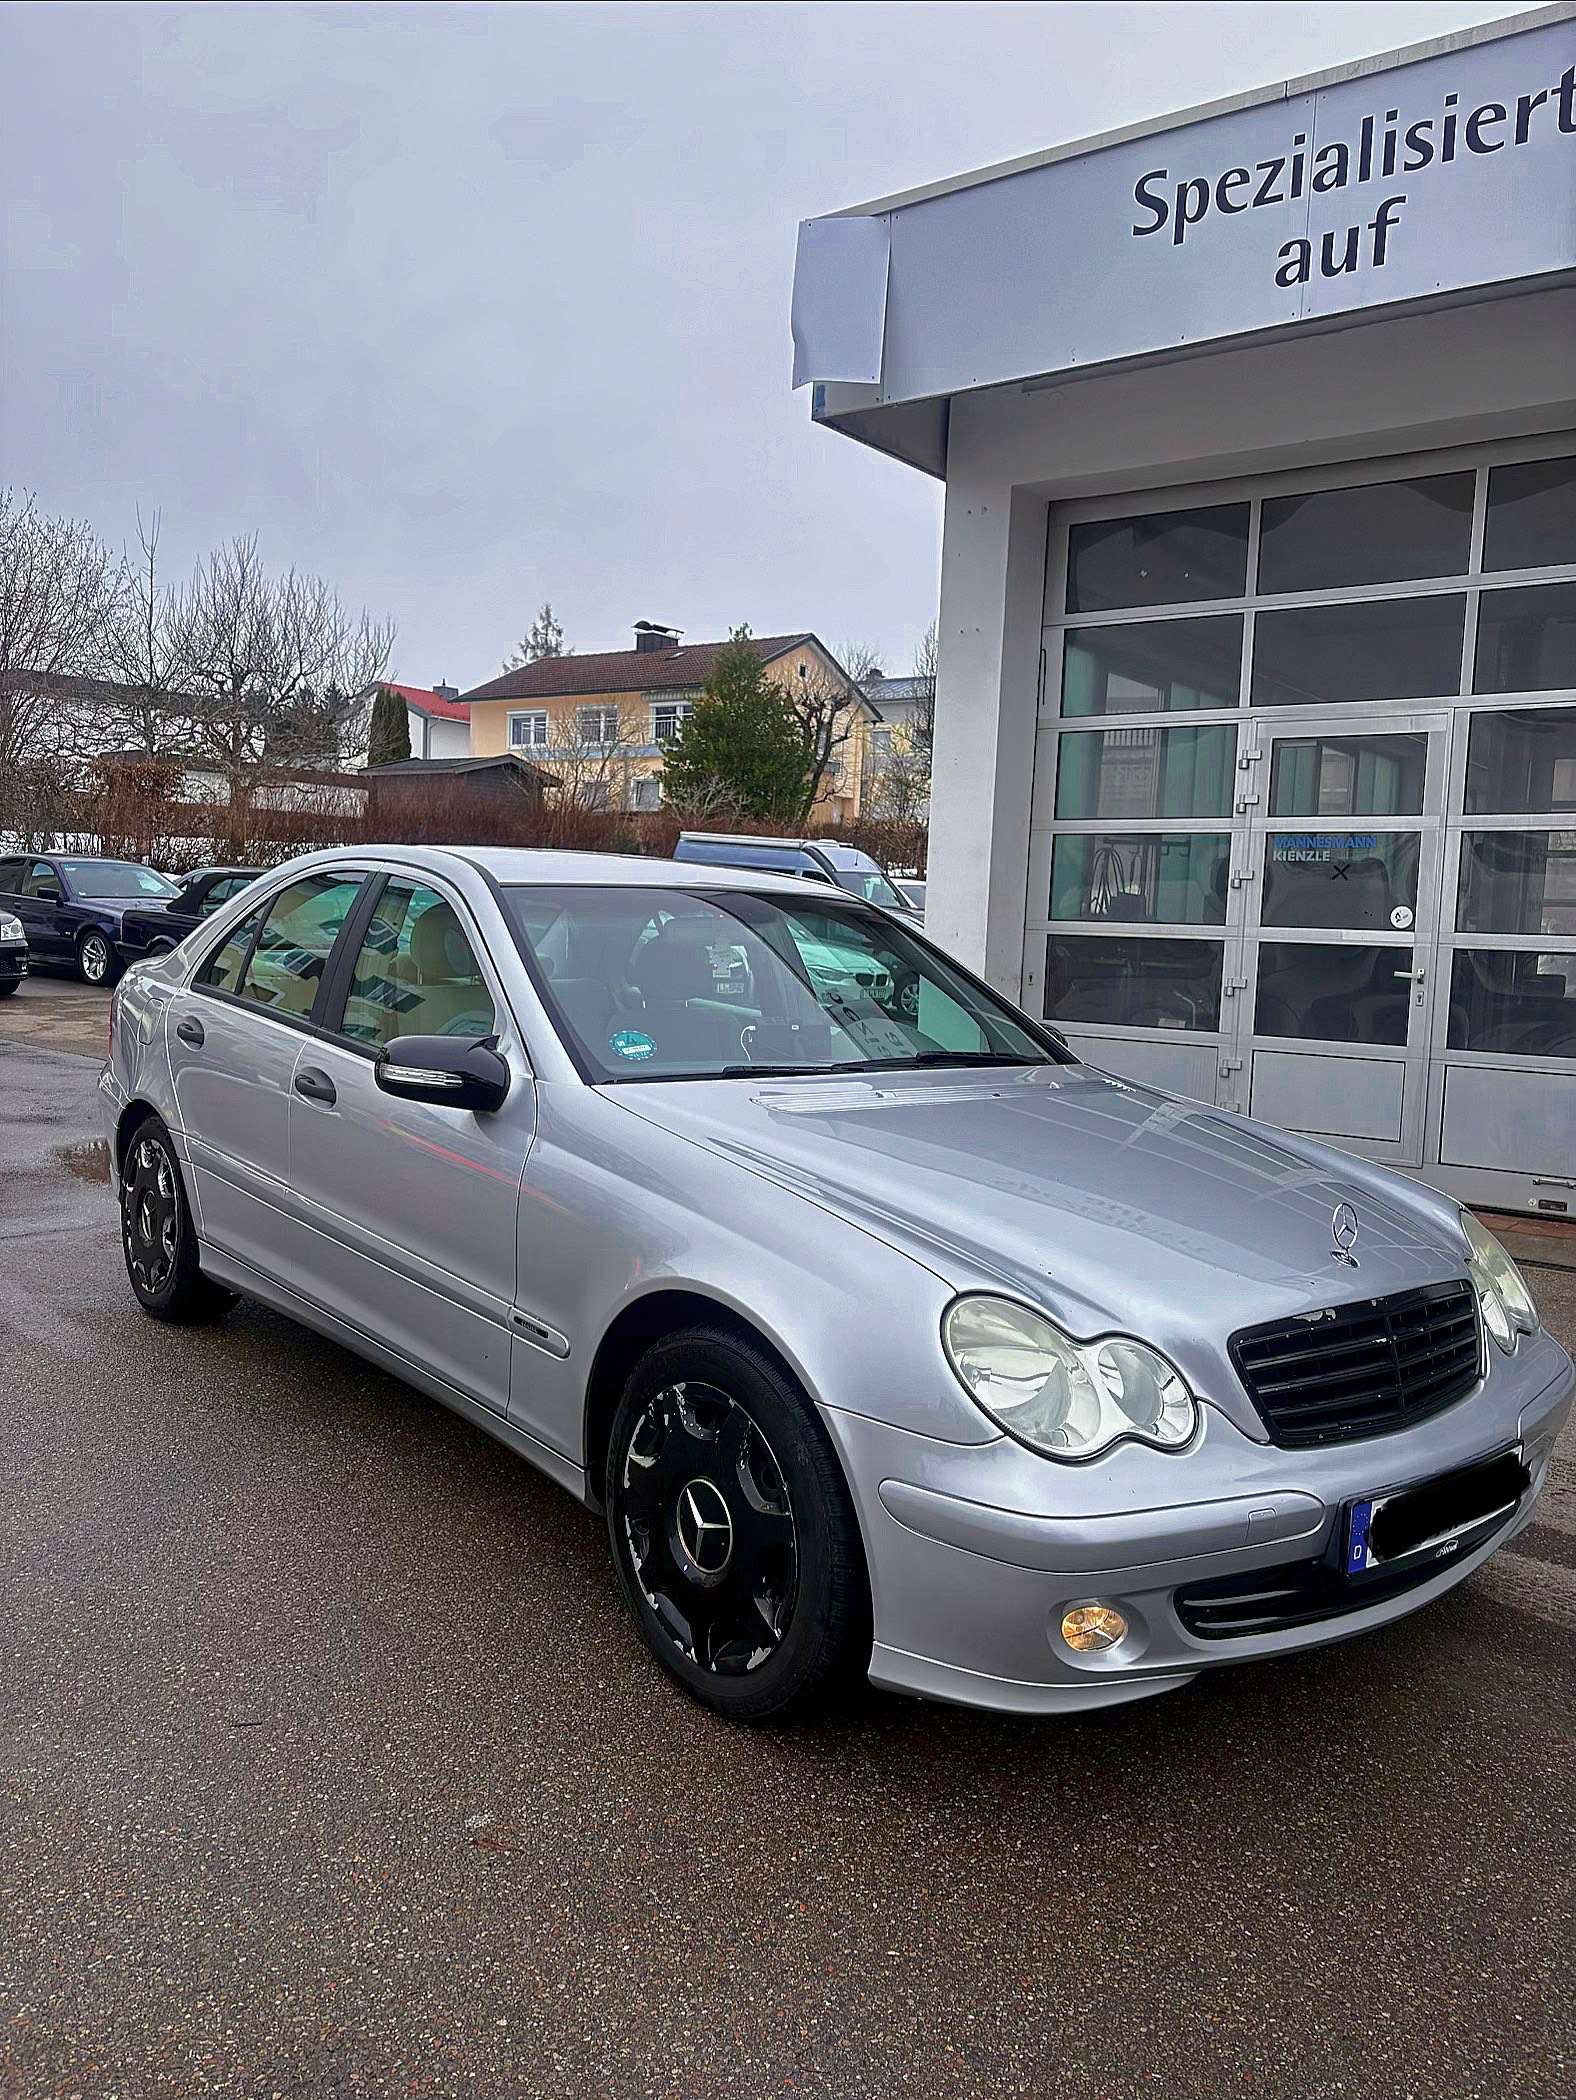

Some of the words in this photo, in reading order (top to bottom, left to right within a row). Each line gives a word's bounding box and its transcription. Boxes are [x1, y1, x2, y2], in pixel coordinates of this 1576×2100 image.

[1131, 66, 1576, 246] Spezialisiert
[1274, 196, 1407, 288] auf
[1274, 836, 1376, 848] MANNESMANN
[1273, 850, 1330, 862] KIENZLE
[1353, 1545, 1362, 1560] D
